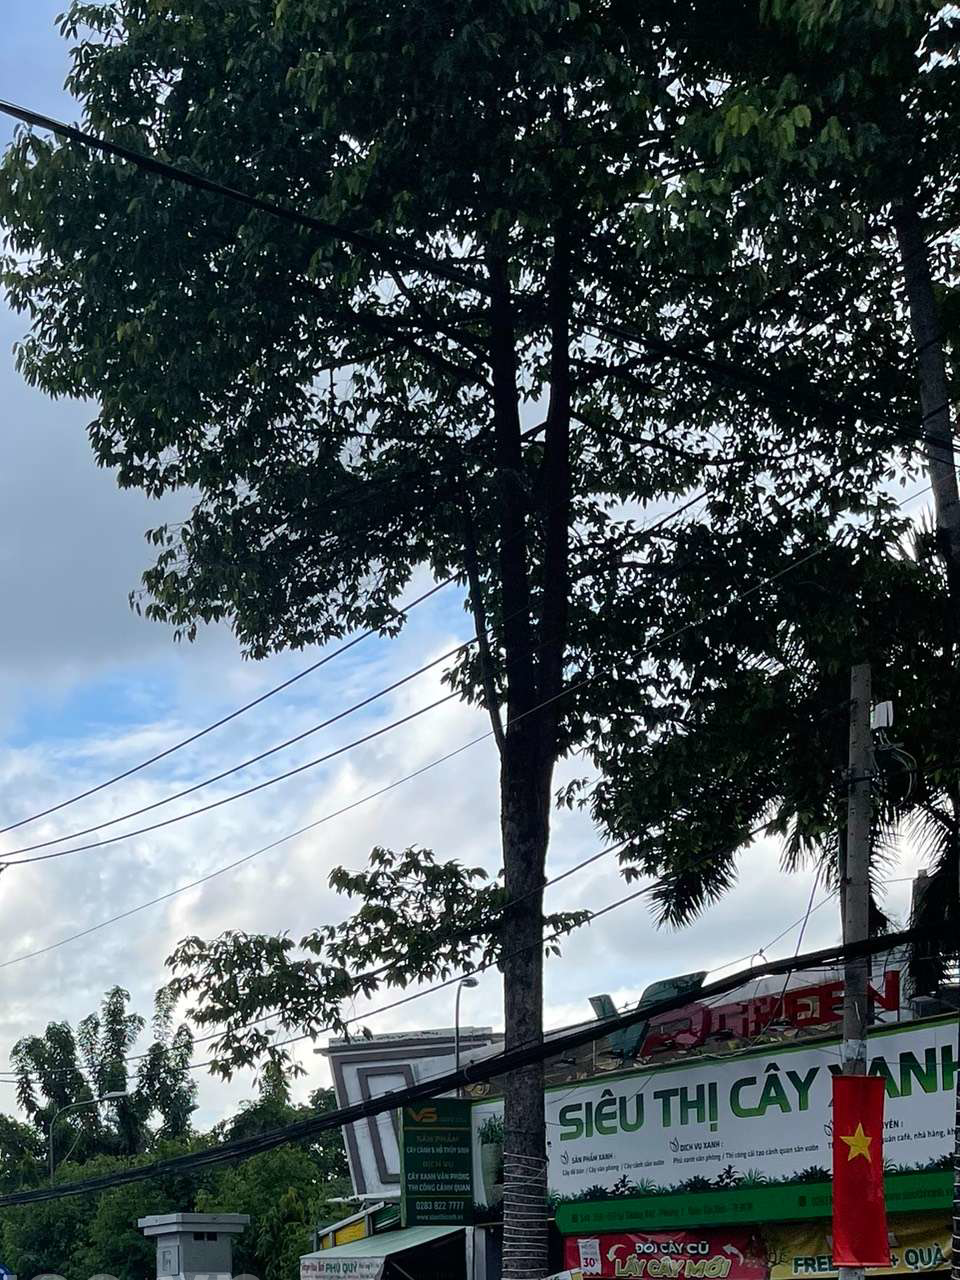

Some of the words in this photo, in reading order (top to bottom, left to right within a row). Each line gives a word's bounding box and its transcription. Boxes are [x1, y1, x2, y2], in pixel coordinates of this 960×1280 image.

[559, 1088, 645, 1141] SIÊU
[654, 1082, 718, 1132] THỊ
[730, 1063, 820, 1118] CÂY
[703, 1141, 721, 1150] XANH
[434, 1201, 447, 1210] 822
[660, 1240, 685, 1254] CÂY
[686, 1241, 710, 1254] CŨ
[615, 1254, 648, 1277] LẤY
[648, 1256, 686, 1277] CÂY
[686, 1255, 732, 1277] MỚI
